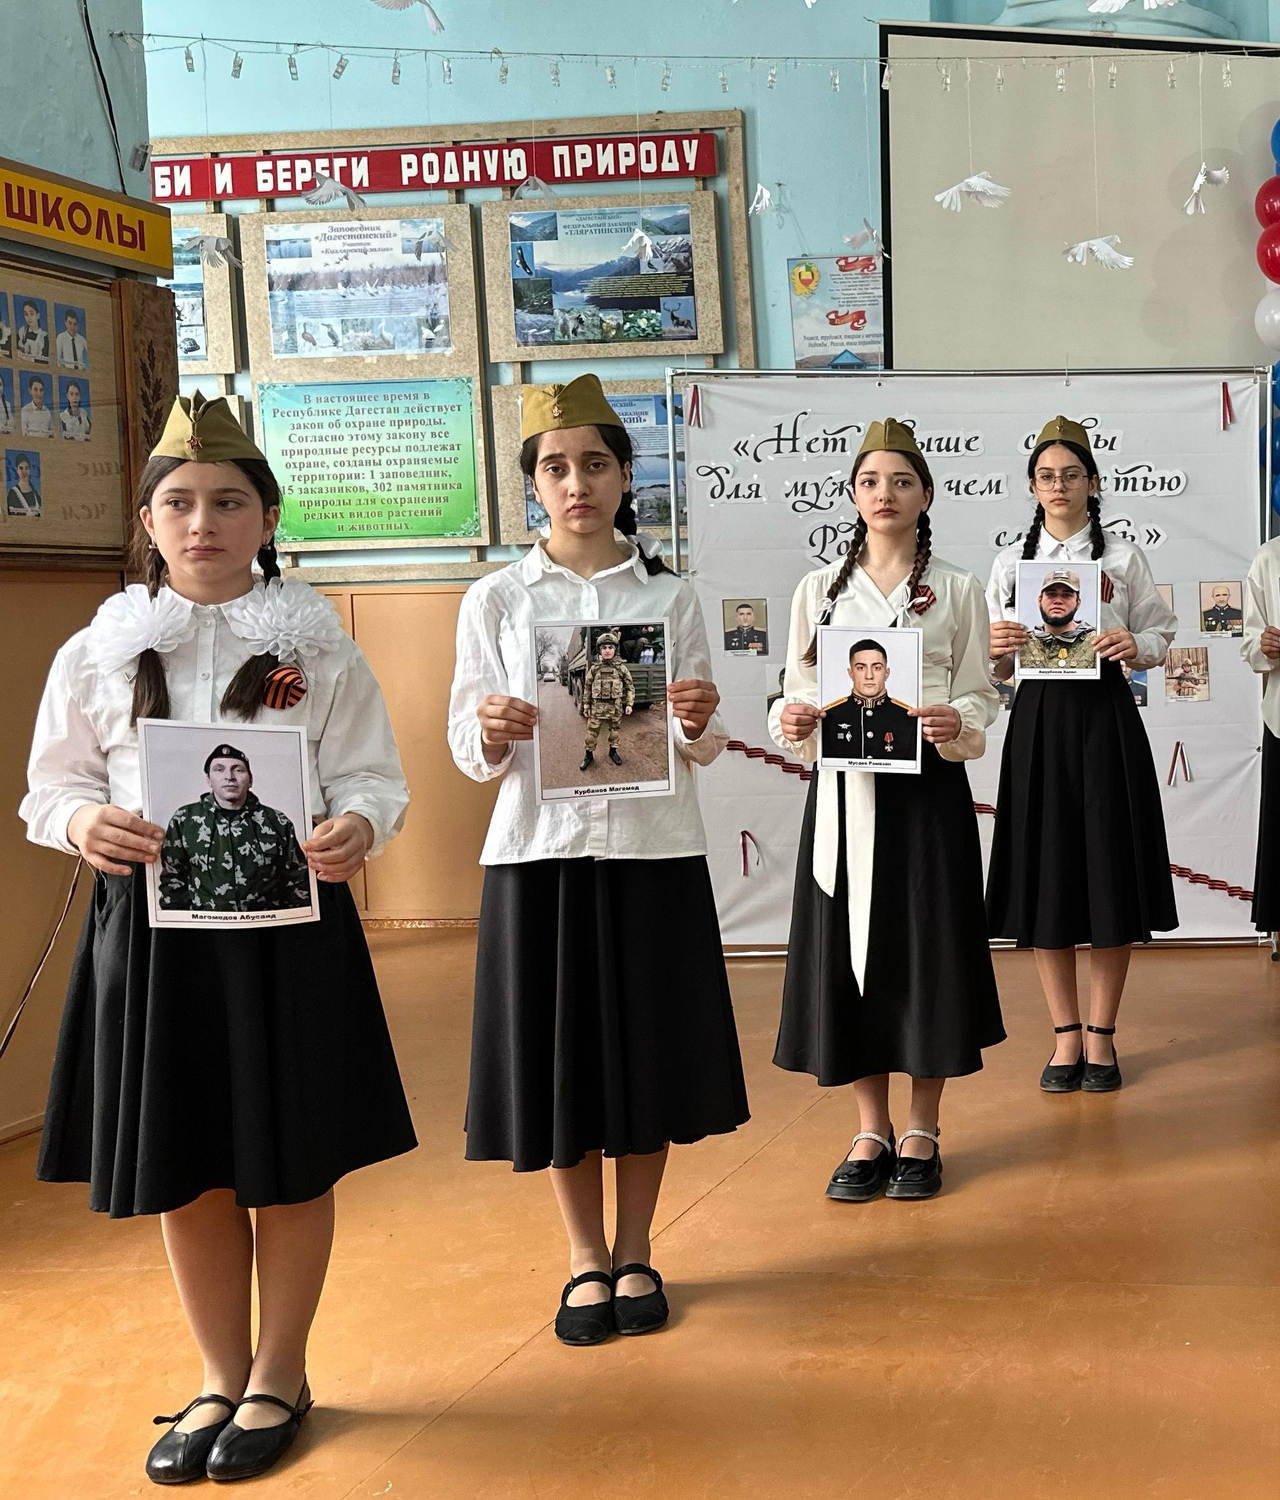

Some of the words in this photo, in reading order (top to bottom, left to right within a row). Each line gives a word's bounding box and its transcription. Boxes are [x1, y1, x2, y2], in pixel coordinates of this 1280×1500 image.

[214, 162, 233, 195] И
[256, 156, 370, 193] БЕРЕГИ
[400, 148, 527, 185] РОДНУЮ
[552, 139, 699, 178] ПРИРОДУ
[4, 182, 146, 252] ШКОЛЫ
[328, 224, 381, 233] Заповедник
[314, 232, 398, 243] «Дагестанский»
[304, 395, 311, 404] В
[316, 394, 379, 403] настоящее
[383, 394, 419, 402] время
[273, 406, 342, 419] Республике
[345, 406, 400, 417] Дагестан
[404, 404, 462, 414] действует
[290, 422, 323, 430] закон
[328, 419, 341, 429] об
[345, 420, 385, 430] охране
[390, 418, 446, 429] природы.
[288, 433, 344, 443] Согласно
[348, 432, 382, 443] этому
[386, 431, 426, 441] закону
[431, 430, 449, 438] все
[733, 411, 862, 463] «Нет
[900, 419, 980, 454] ыше
[281, 447, 348, 458] природные
[352, 445, 401, 456] ресурсы
[406, 443, 462, 453] подлежат
[285, 460, 330, 471] охране,
[334, 459, 381, 468] созданы
[386, 456, 459, 467] охраняемые
[290, 472, 365, 484] территории:
[370, 470, 374, 480] 1
[379, 470, 452, 481] заповедник,
[696, 465, 763, 500] для
[943, 478, 1003, 497] чем
[298, 484, 369, 495] заказников,
[372, 483, 392, 492] 302
[396, 482, 462, 491] памятника
[300, 498, 351, 509] природы
[356, 497, 376, 505] для
[381, 495, 449, 506] сохранения
[304, 512, 344, 522] редких
[349, 510, 383, 519] видов
[388, 508, 442, 519] растений
[338, 524, 345, 532] и
[349, 522, 414, 531] животных.
[574, 788, 607, 796] Курбанов
